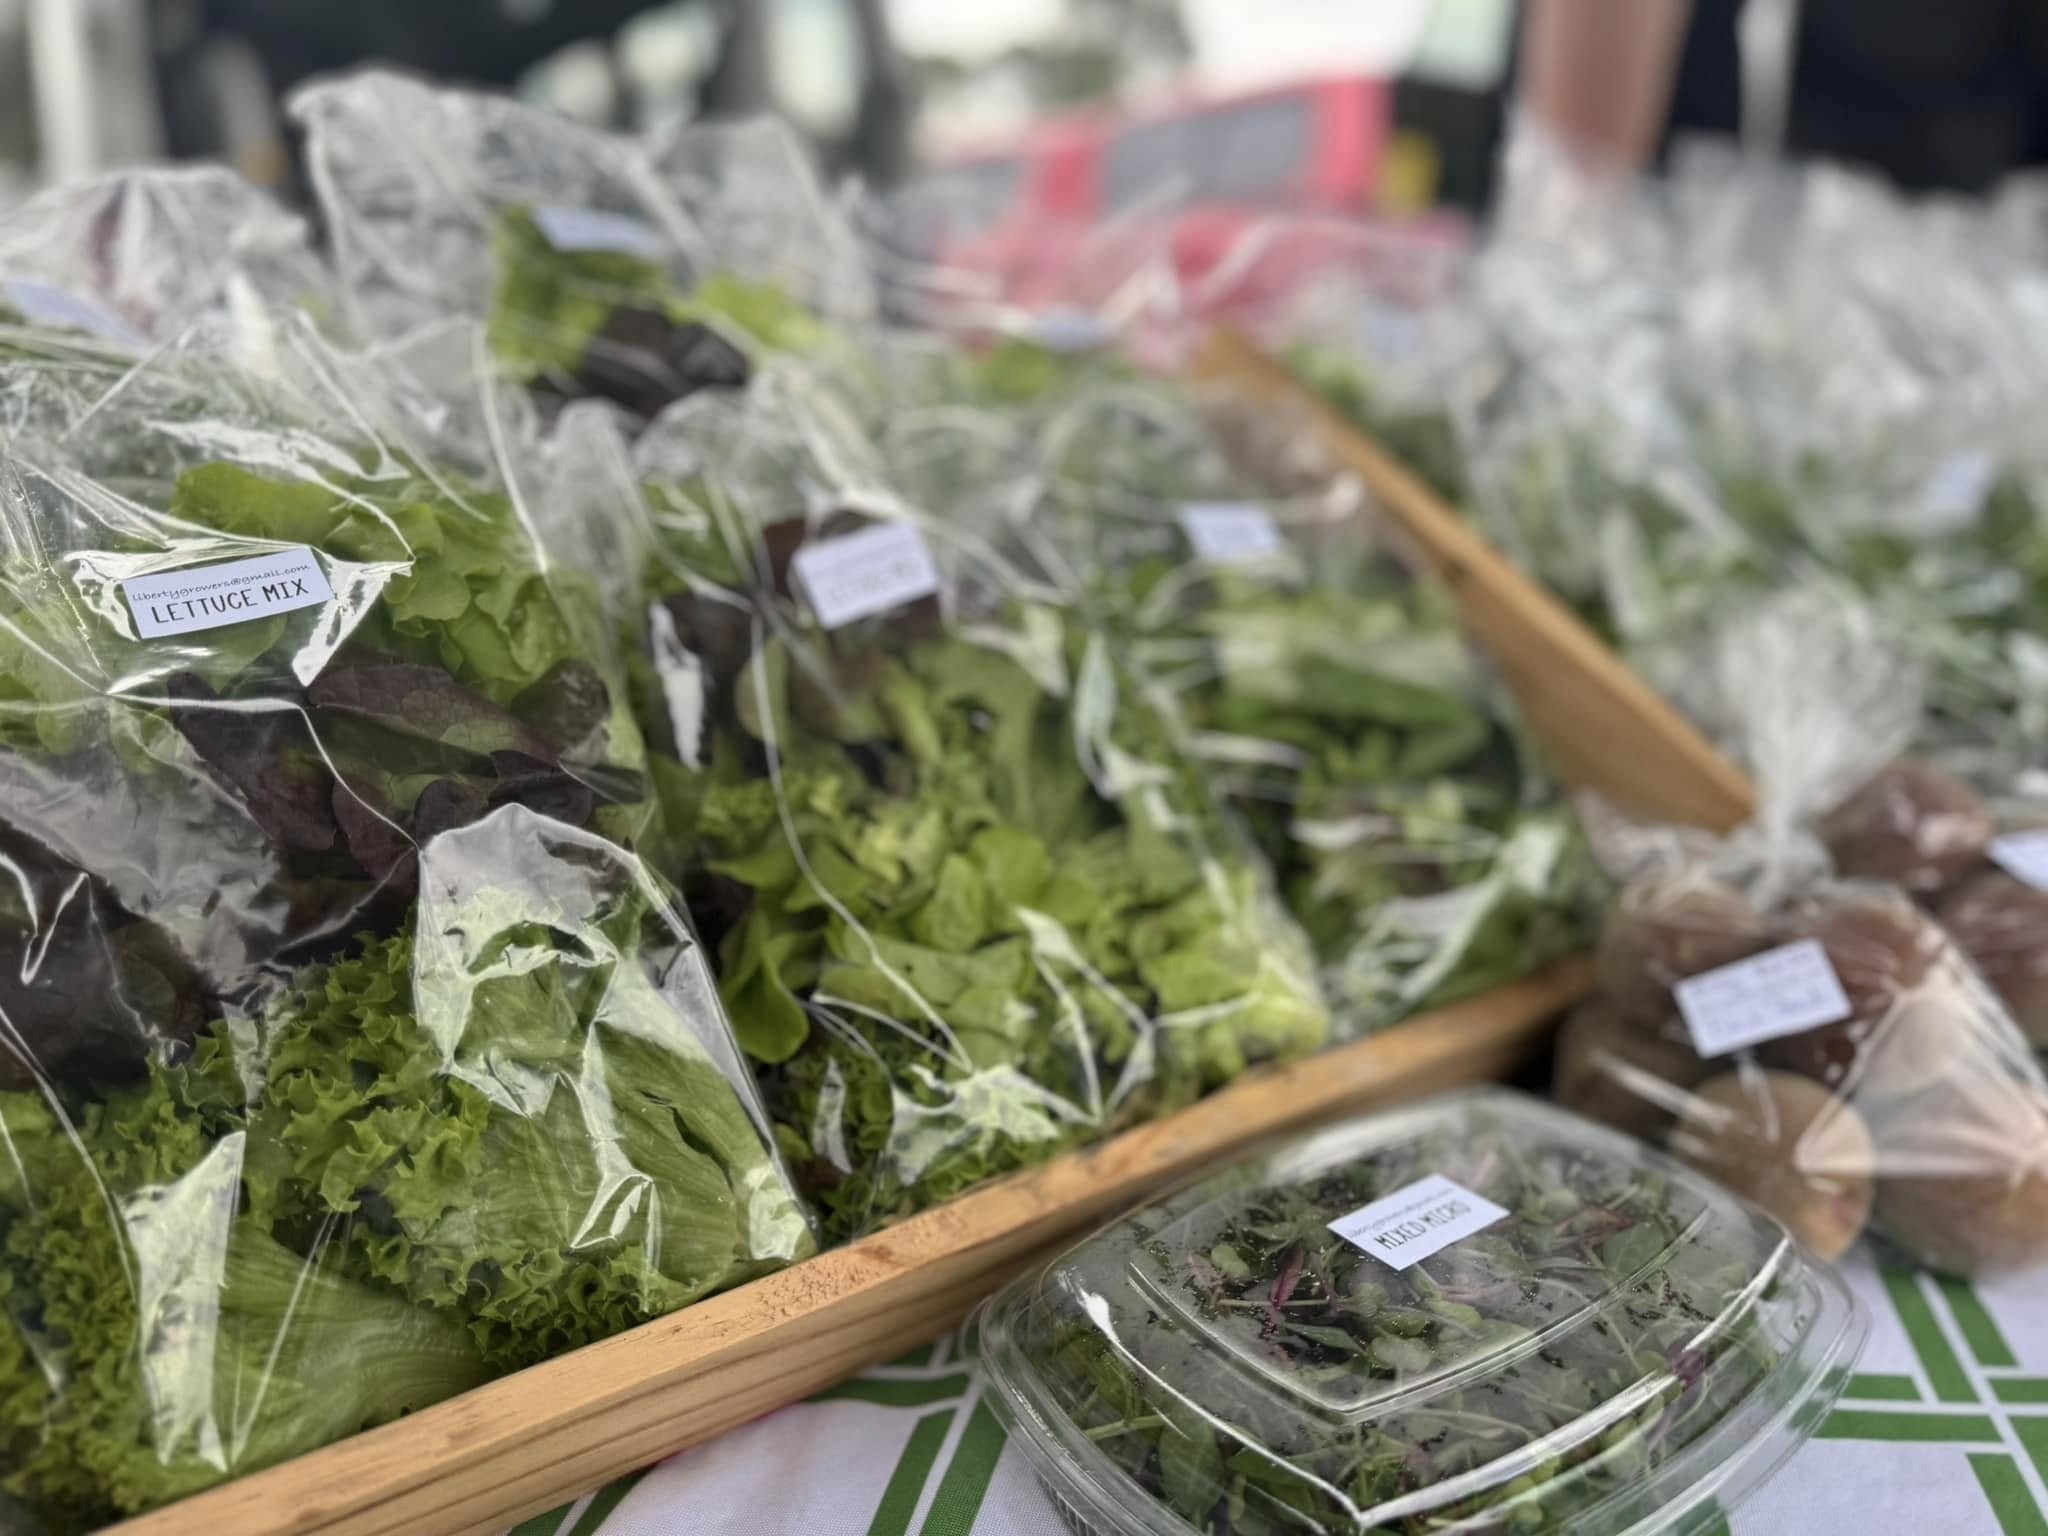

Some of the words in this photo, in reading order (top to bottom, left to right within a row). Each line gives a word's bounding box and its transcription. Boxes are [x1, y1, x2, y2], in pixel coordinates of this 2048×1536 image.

[151, 588, 258, 624] LETTUCE
[261, 578, 309, 603] MIX
[1373, 1220, 1427, 1250] MIXED
[1419, 1199, 1472, 1229] MICRO
